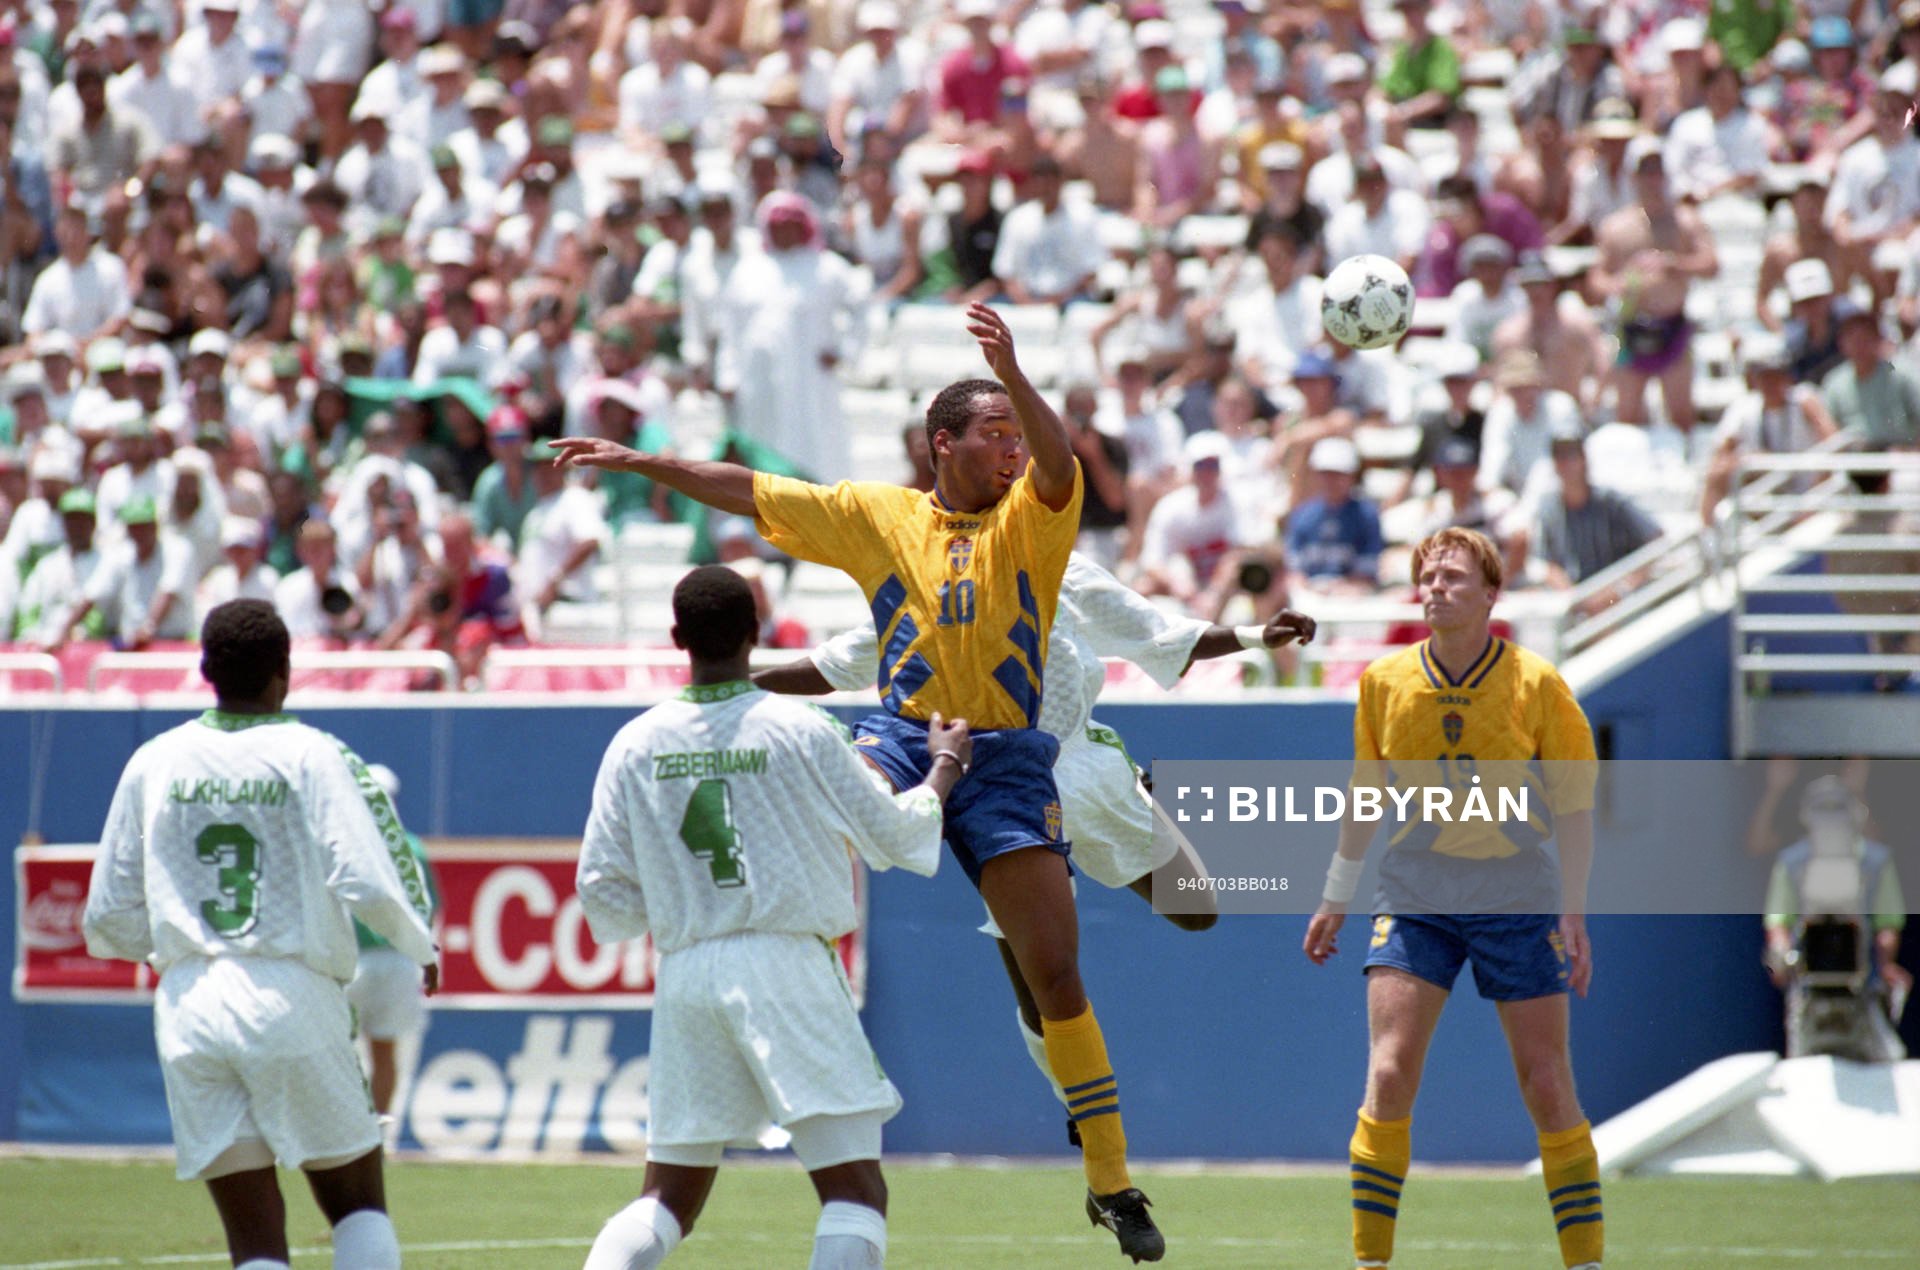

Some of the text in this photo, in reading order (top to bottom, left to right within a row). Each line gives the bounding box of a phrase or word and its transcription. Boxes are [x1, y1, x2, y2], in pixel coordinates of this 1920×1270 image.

[937, 579, 976, 625] 10
[1436, 753, 1478, 790] 19
[679, 778, 746, 888] 4
[195, 823, 263, 939] 3
